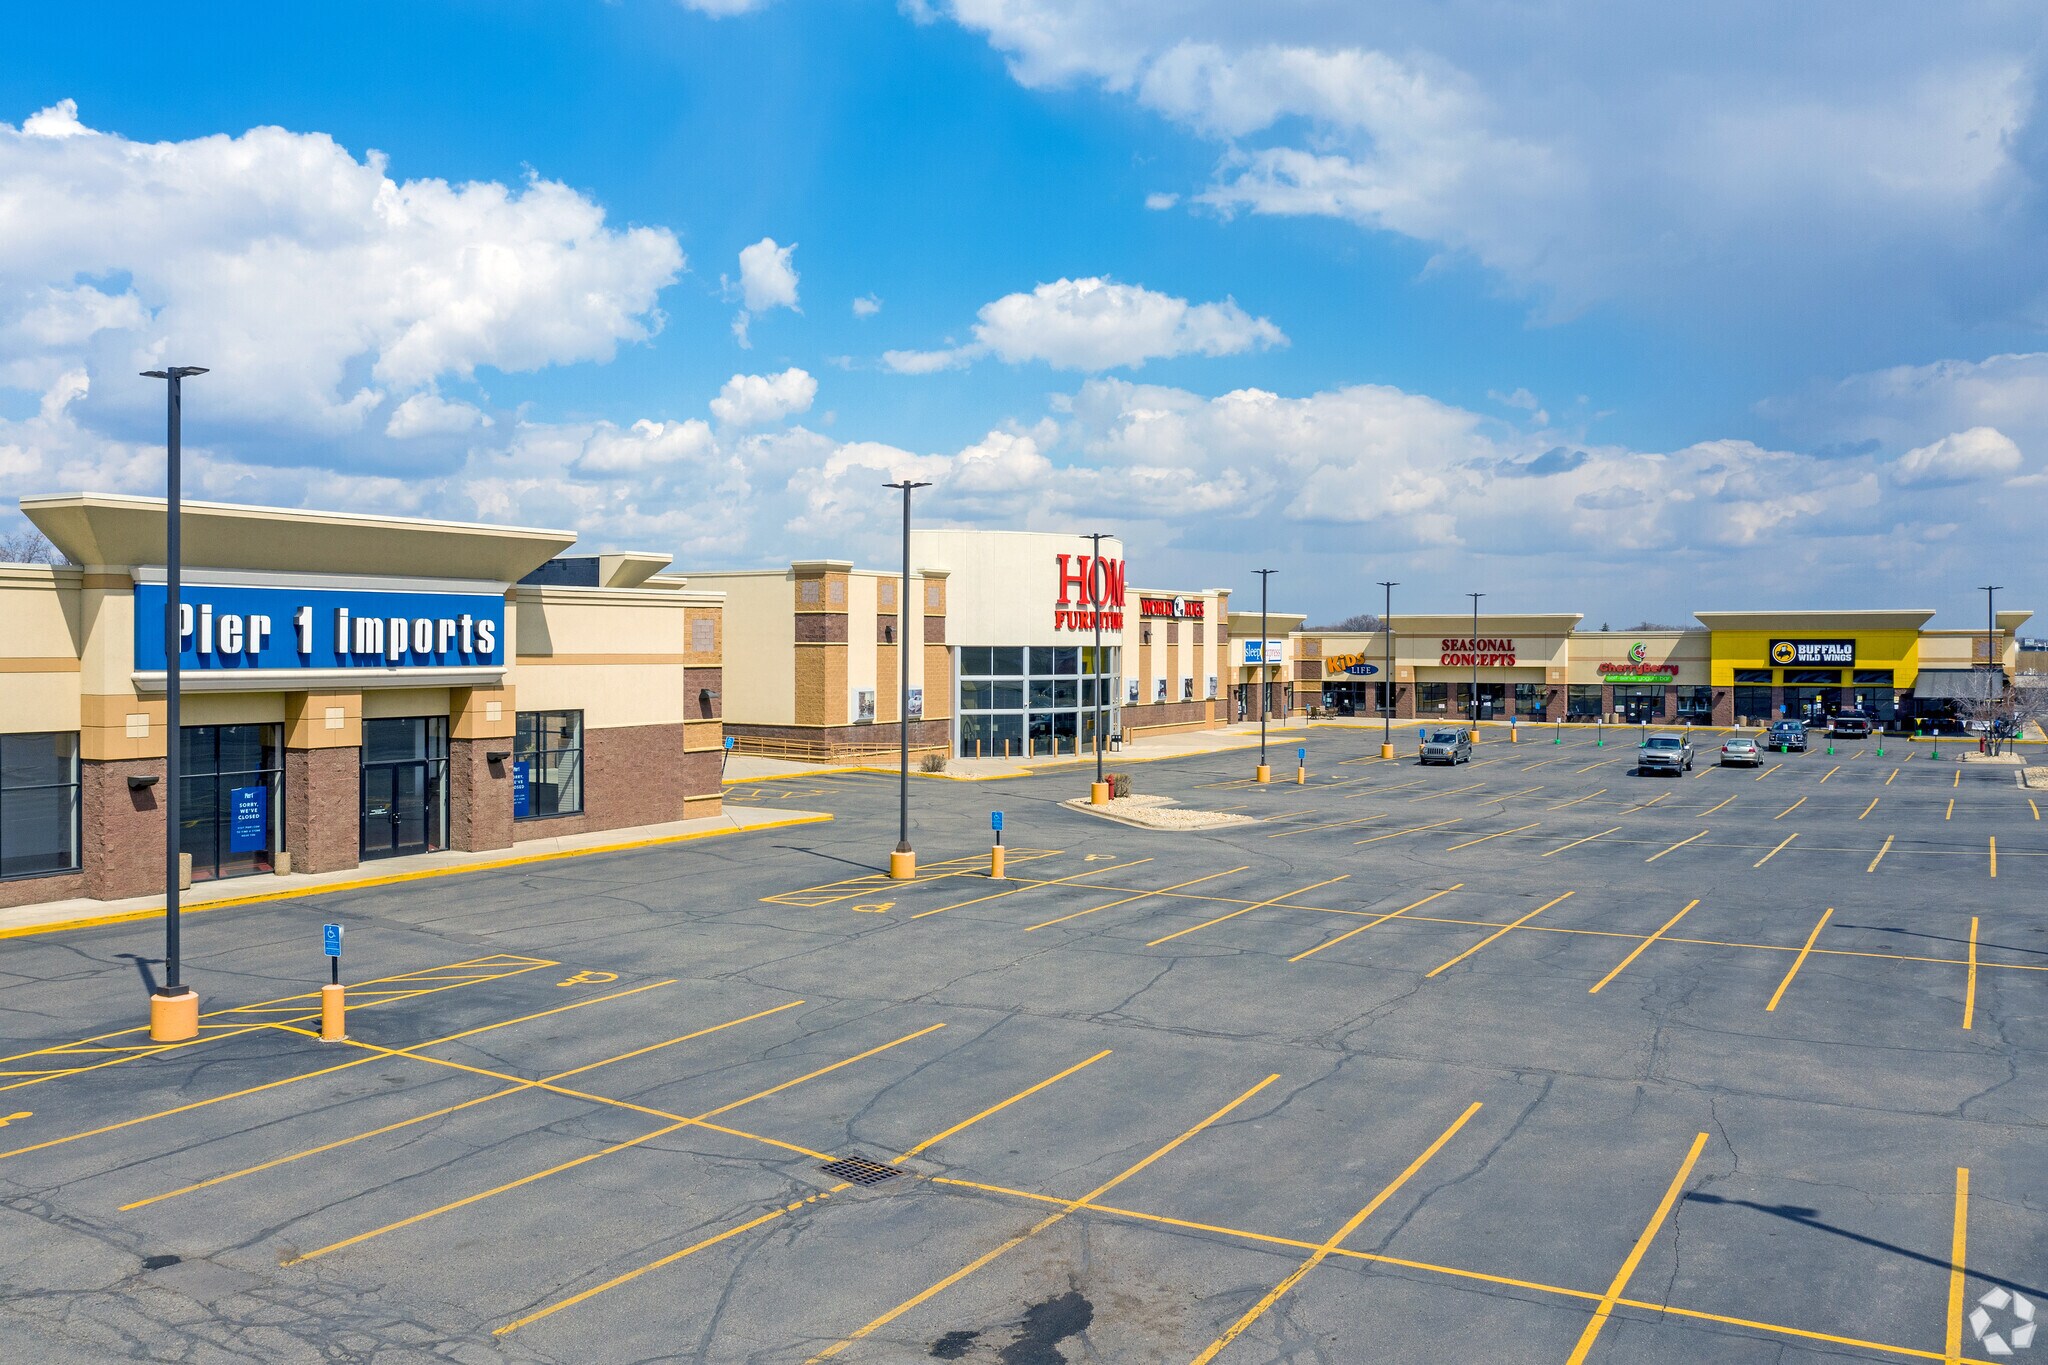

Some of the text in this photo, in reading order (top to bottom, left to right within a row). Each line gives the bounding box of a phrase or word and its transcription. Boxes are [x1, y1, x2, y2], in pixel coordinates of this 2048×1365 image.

[1055, 553, 1126, 607] HOM
[1141, 600, 1204, 617] WORLD RUGS
[178, 603, 495, 661] Pier 1 imports
[1245, 644, 1261, 660] sleep
[1441, 639, 1515, 652] SEASONAL
[1797, 644, 1852, 654] BUFFALO
[1441, 653, 1516, 666] CONCEPTS
[1797, 653, 1852, 662] WILD WINGS
[1351, 666, 1372, 674] LIFE
[1599, 662, 1679, 676] CherryBerry
